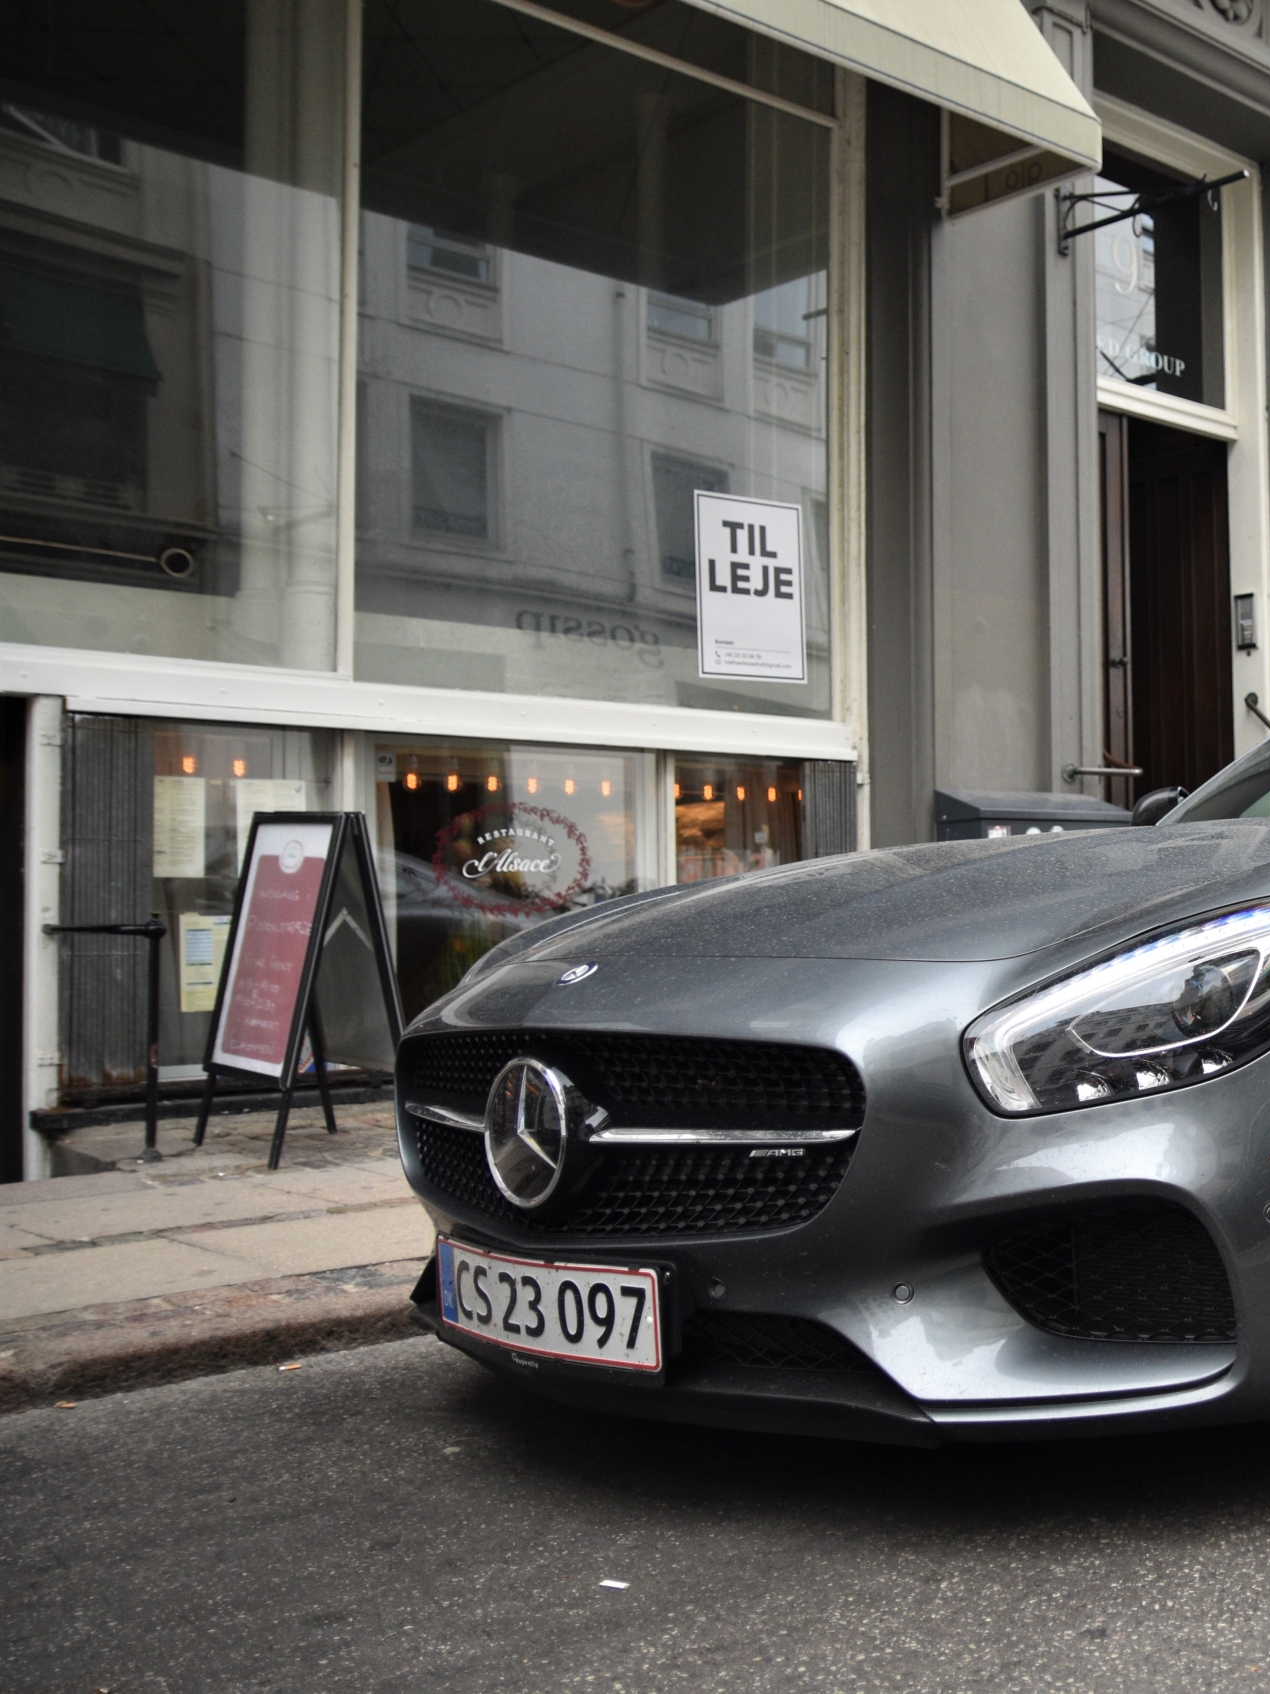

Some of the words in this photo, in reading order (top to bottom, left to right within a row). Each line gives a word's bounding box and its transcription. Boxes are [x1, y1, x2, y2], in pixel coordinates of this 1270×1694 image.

[1112, 233, 1139, 295] 9
[1126, 346, 1186, 377] GROUP
[722, 519, 778, 559] TIL
[708, 558, 794, 600] LEJE
[476, 828, 555, 846] RESTAURANT
[557, 1279, 646, 1350] 097
